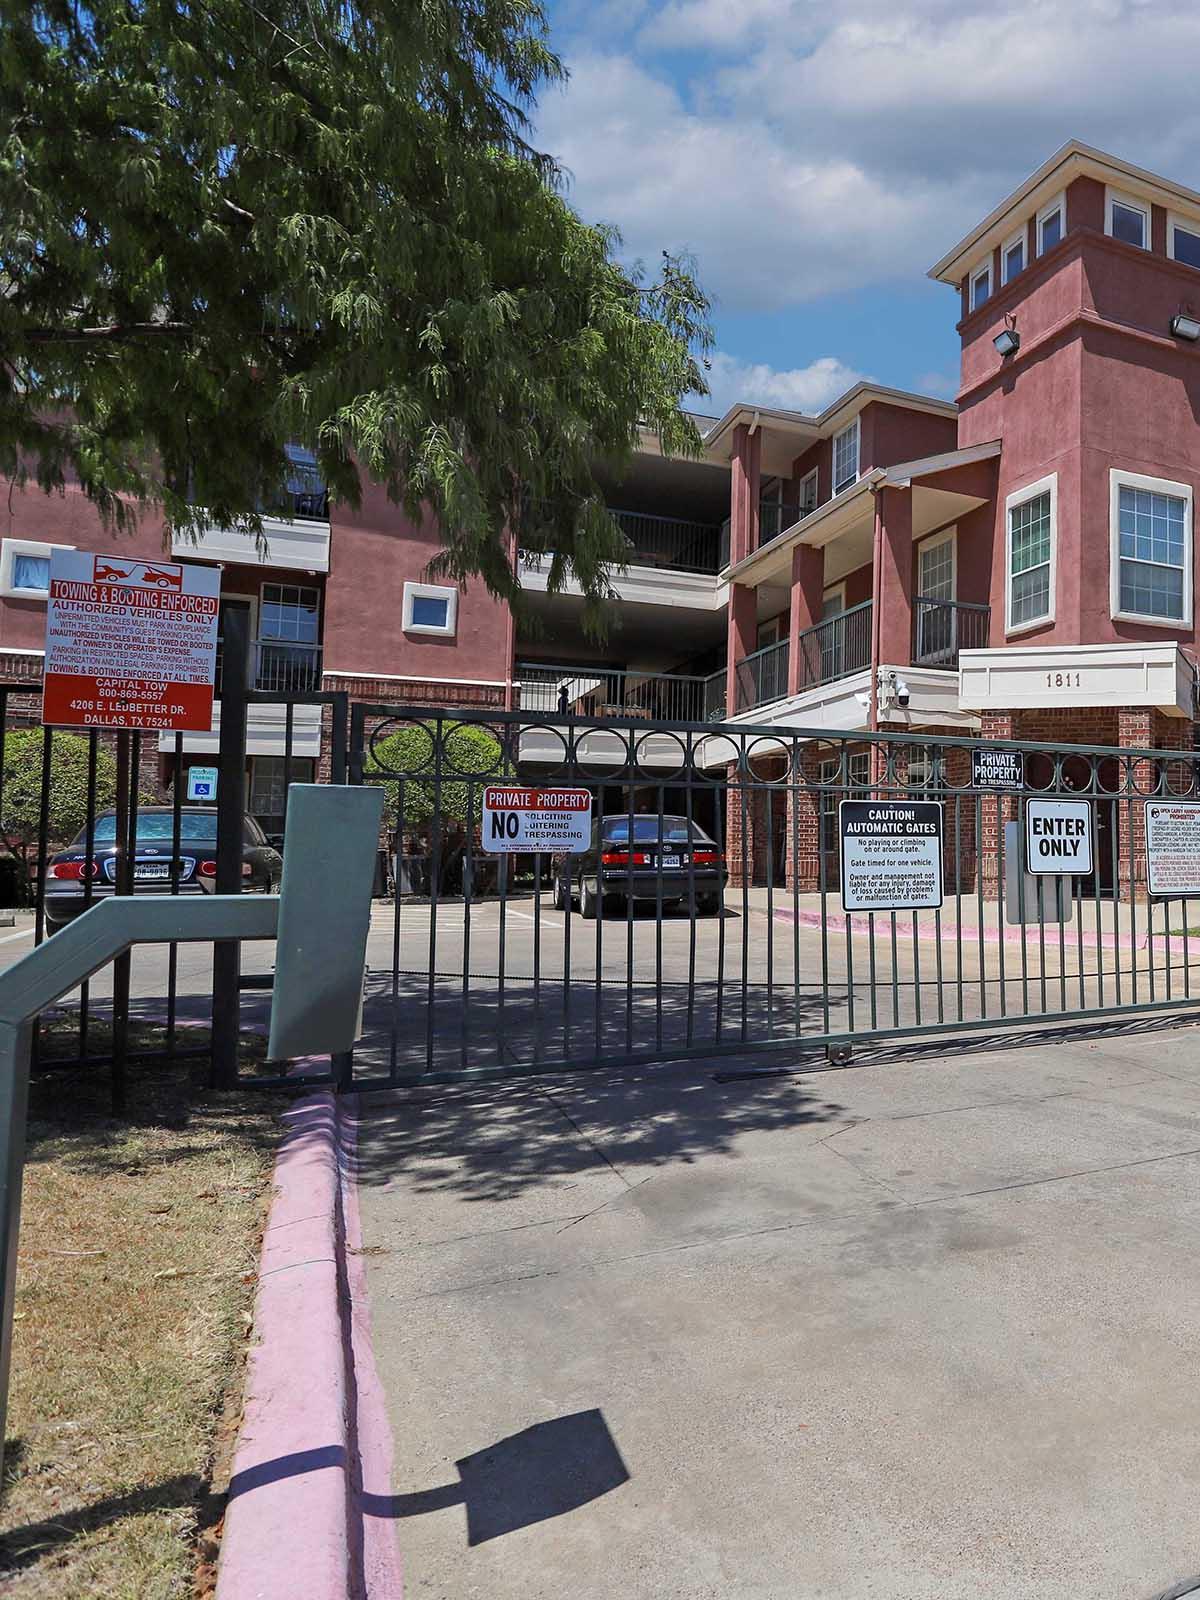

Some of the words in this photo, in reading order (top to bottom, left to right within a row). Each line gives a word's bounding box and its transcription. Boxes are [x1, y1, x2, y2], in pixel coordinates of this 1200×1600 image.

[54, 581, 98, 601] TOWING
[100, 586, 108, 602] &
[111, 588, 158, 608] BOOTING
[160, 593, 215, 614] ENFORCED
[52, 600, 126, 616] AUTHORIZED
[130, 608, 182, 622] VEHICLES
[186, 614, 214, 624] ONLY
[54, 611, 100, 622] UNPERMITTED
[102, 616, 130, 625] VEHICLES
[174, 624, 211, 634] COMPLIANCE
[78, 622, 90, 630] THE
[135, 628, 155, 636] GUEST
[156, 630, 182, 639] PARKING
[50, 628, 100, 639] UNAUTHORIZED
[100, 633, 130, 642] VEHICLES
[132, 636, 146, 644] WILL
[157, 638, 178, 646] TOWED
[180, 640, 188, 648] OR
[190, 642, 214, 650] BOOTED
[83, 640, 112, 649] OWNER'S
[113, 642, 122, 650] OR
[124, 644, 162, 654] OPERATOR'S
[52, 646, 80, 655] PARKING
[90, 648, 128, 658] RESTRICTED
[156, 654, 182, 664] PARKING
[100, 658, 114, 666] AND
[49, 664, 78, 673] TOWING
[80, 666, 86, 674] &
[88, 666, 121, 676] BOOTING
[123, 670, 161, 680] ENFORCED
[163, 672, 172, 680] AT
[174, 673, 188, 682] ALL
[1047, 673, 1080, 687] 1811
[96, 678, 141, 690] CAPITAL
[144, 682, 168, 690] TOW
[99, 688, 164, 700] 800-869-5557
[70, 700, 94, 710] 4206
[97, 702, 106, 711] E.
[170, 706, 187, 715] DR.
[84, 714, 128, 726] DALLAS,
[131, 716, 144, 726] TX
[146, 718, 173, 727] 75241
[980, 753, 1016, 766] PRIVATE
[975, 766, 1021, 780] PROPERTY
[489, 792, 532, 806] PRIVATE
[537, 794, 588, 808] PROPERTY
[868, 810, 915, 820] CAUTION!
[492, 812, 520, 839] NO
[846, 823, 903, 833] AUTOMATIC
[906, 823, 936, 833] GATES
[1032, 818, 1086, 836] ENTER
[868, 839, 891, 847] playing
[1039, 838, 1080, 856] ONLY
[868, 880, 878, 888] for
[896, 886, 904, 894] by
[906, 886, 934, 894] problems
